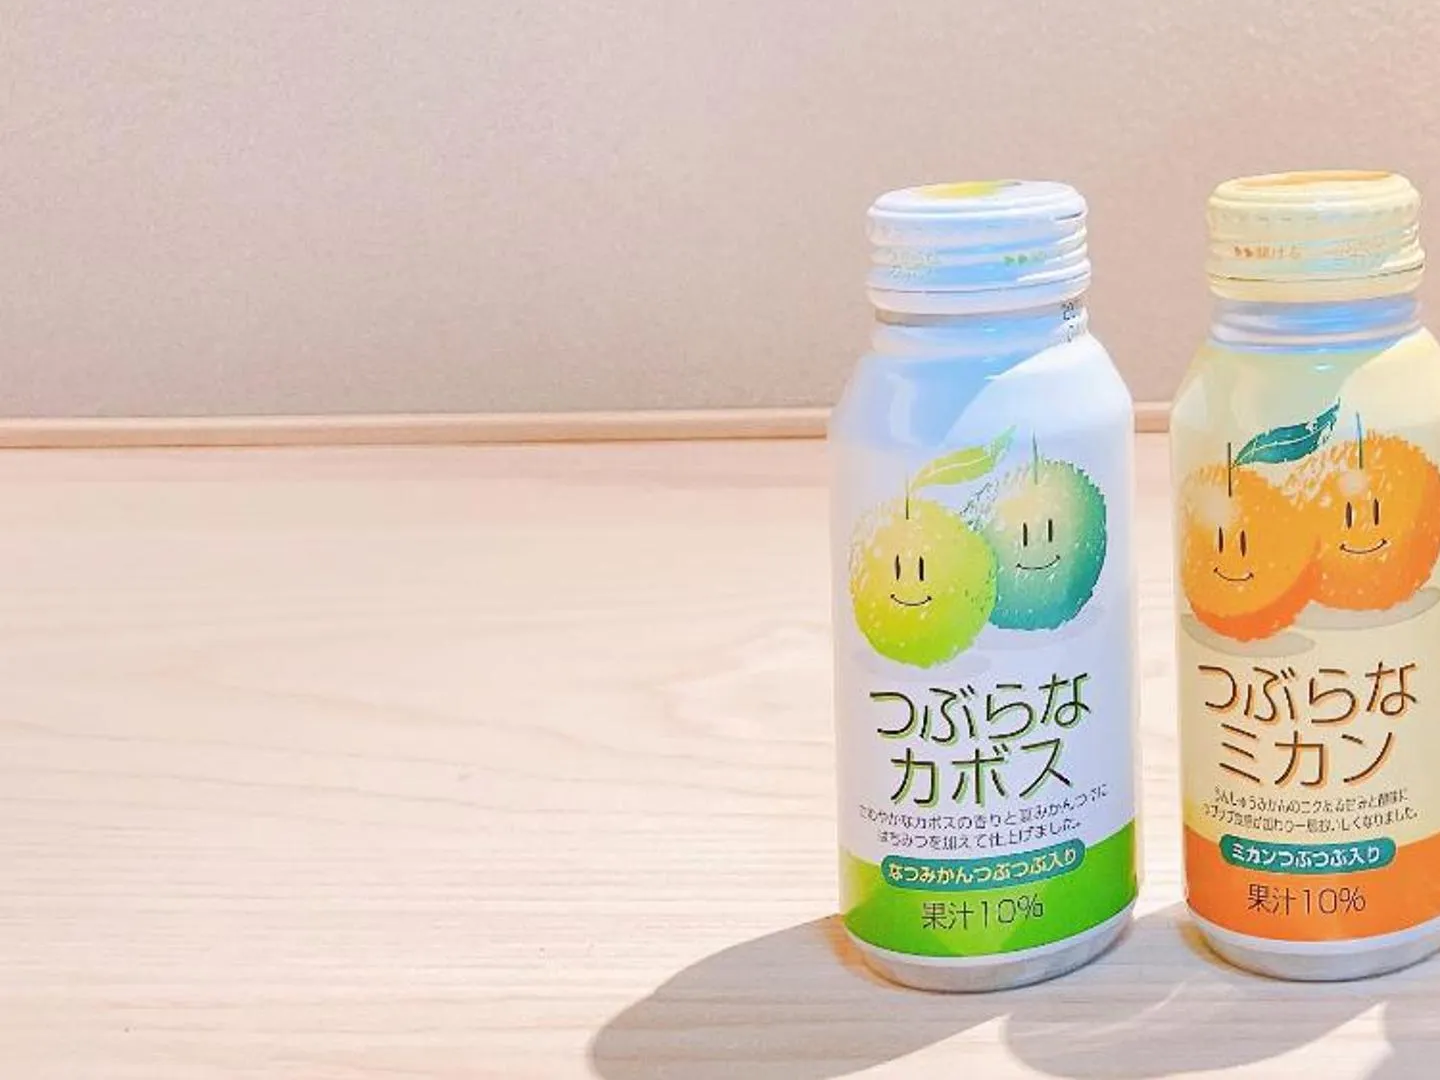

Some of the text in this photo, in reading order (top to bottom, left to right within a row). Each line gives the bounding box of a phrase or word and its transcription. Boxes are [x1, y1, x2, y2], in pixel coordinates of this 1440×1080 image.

[870, 673, 1092, 743] つぶらな
[1198, 661, 1418, 723] つぶらな
[891, 738, 1074, 806] カボス
[1218, 722, 1394, 787] ミカン
[888, 848, 1076, 885] なつみかんつぶつぶ入り
[1231, 843, 1380, 869] ミカンつぶつぶ入り
[921, 894, 1043, 930] 果汁10%
[1248, 883, 1366, 916] 果汁10%
